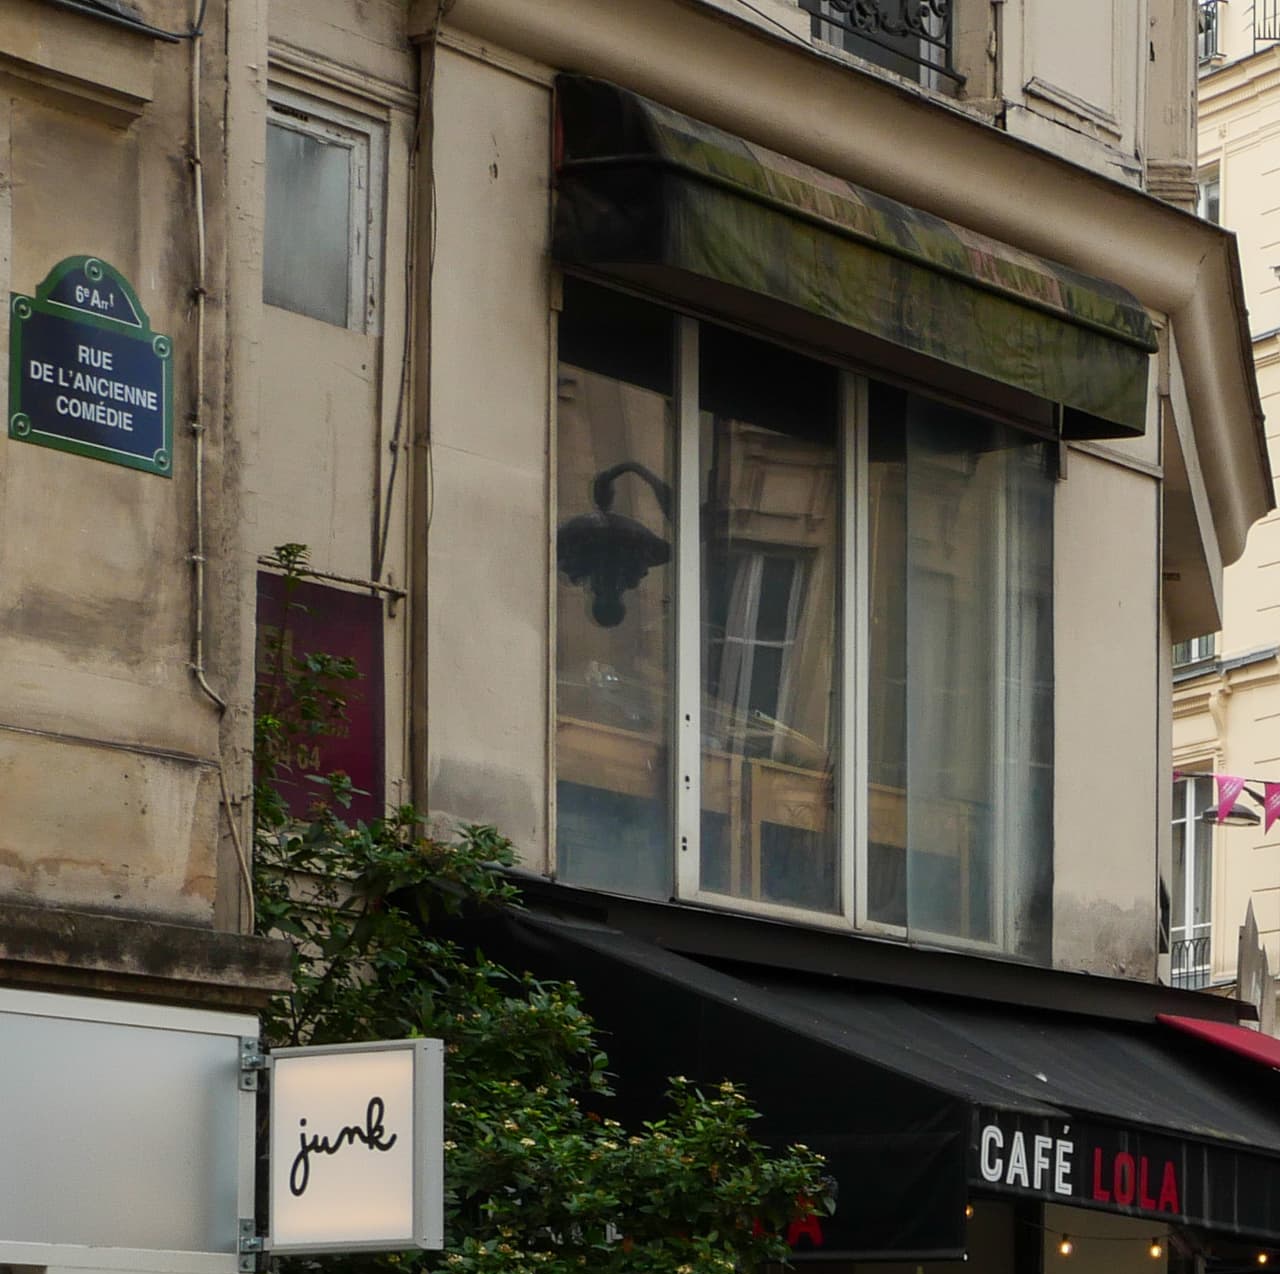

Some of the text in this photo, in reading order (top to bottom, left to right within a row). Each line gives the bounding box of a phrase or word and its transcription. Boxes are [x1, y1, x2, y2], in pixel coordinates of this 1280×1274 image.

[78, 344, 113, 371] RUE
[30, 360, 158, 410] DE L'ANCIENNE
[56, 394, 134, 431] COMÉDIE
[289, 1096, 398, 1197] junk
[979, 1123, 1180, 1214] CAFÉ LOLA
